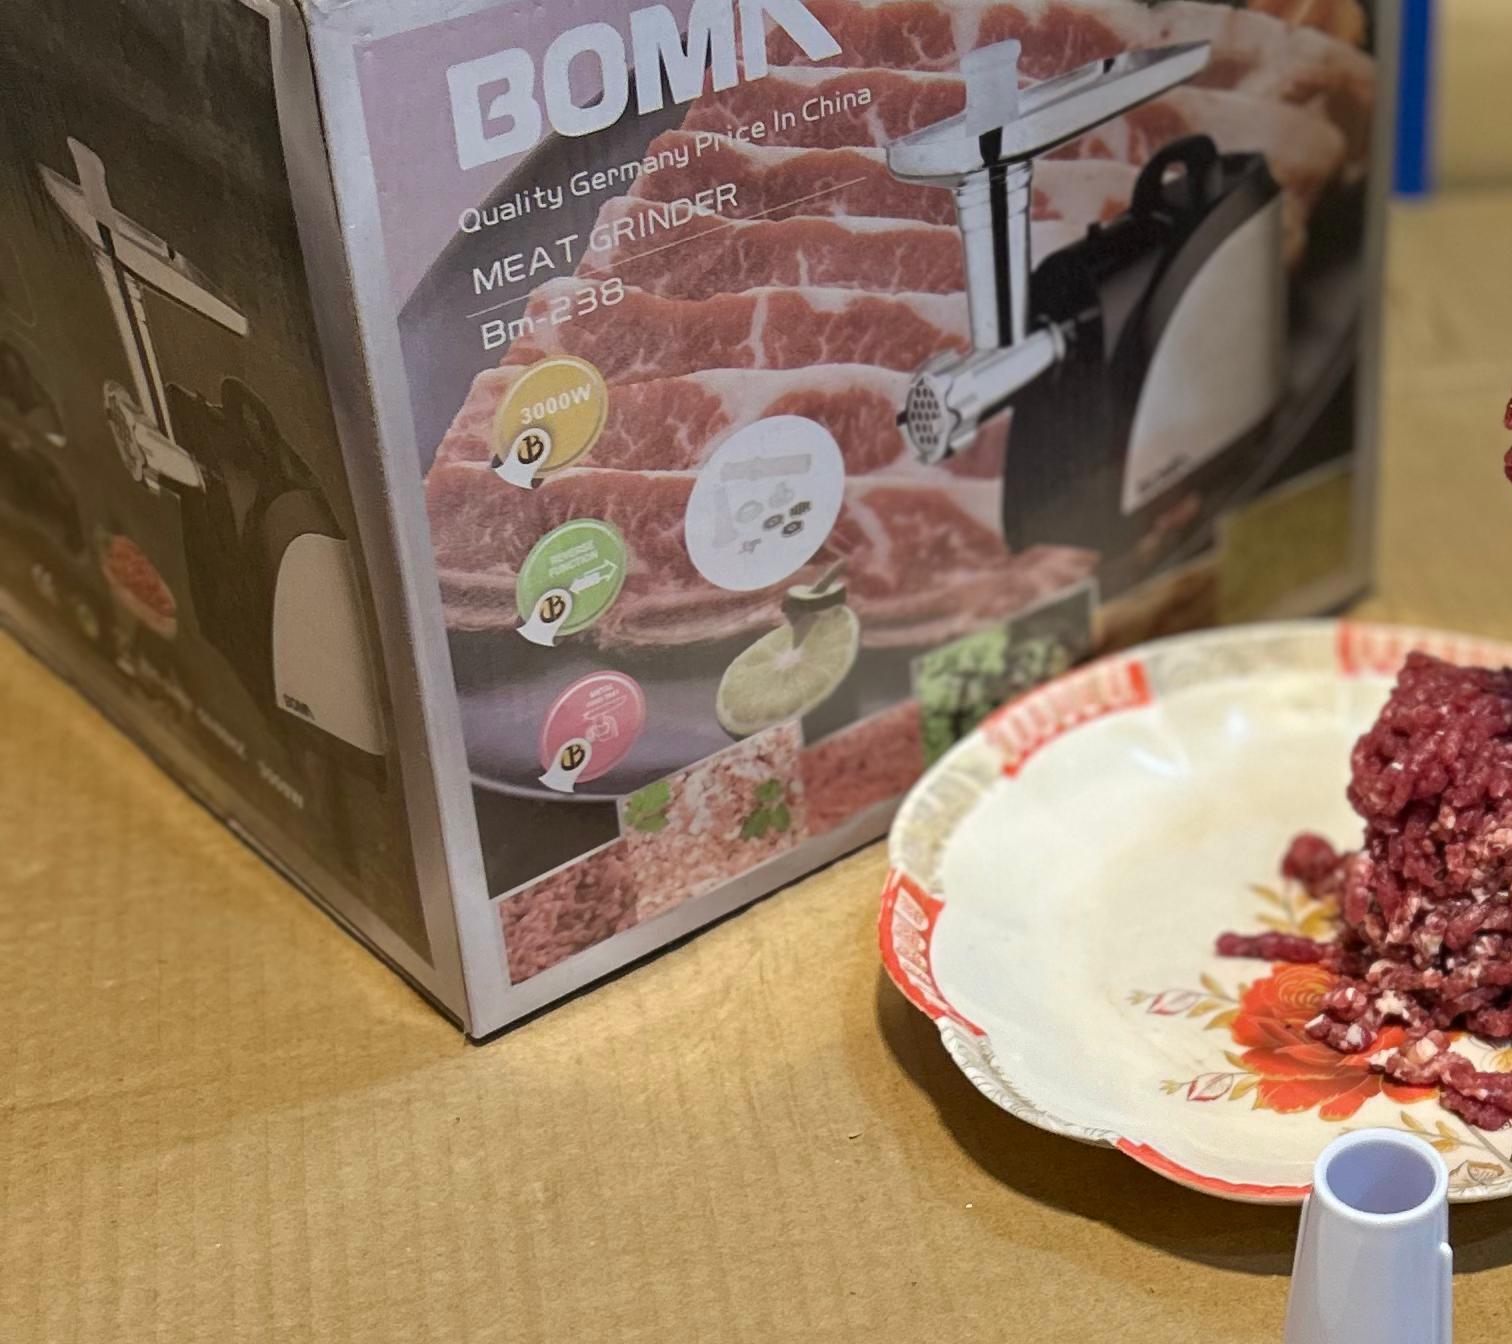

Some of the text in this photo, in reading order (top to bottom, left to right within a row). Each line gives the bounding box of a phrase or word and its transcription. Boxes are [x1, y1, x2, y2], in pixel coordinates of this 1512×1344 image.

[459, 84, 872, 234] Quality Germany Price In China
[472, 183, 738, 295] MEAT GRINDER
[481, 277, 625, 351] Bm-238
[519, 383, 592, 425] 3000W
